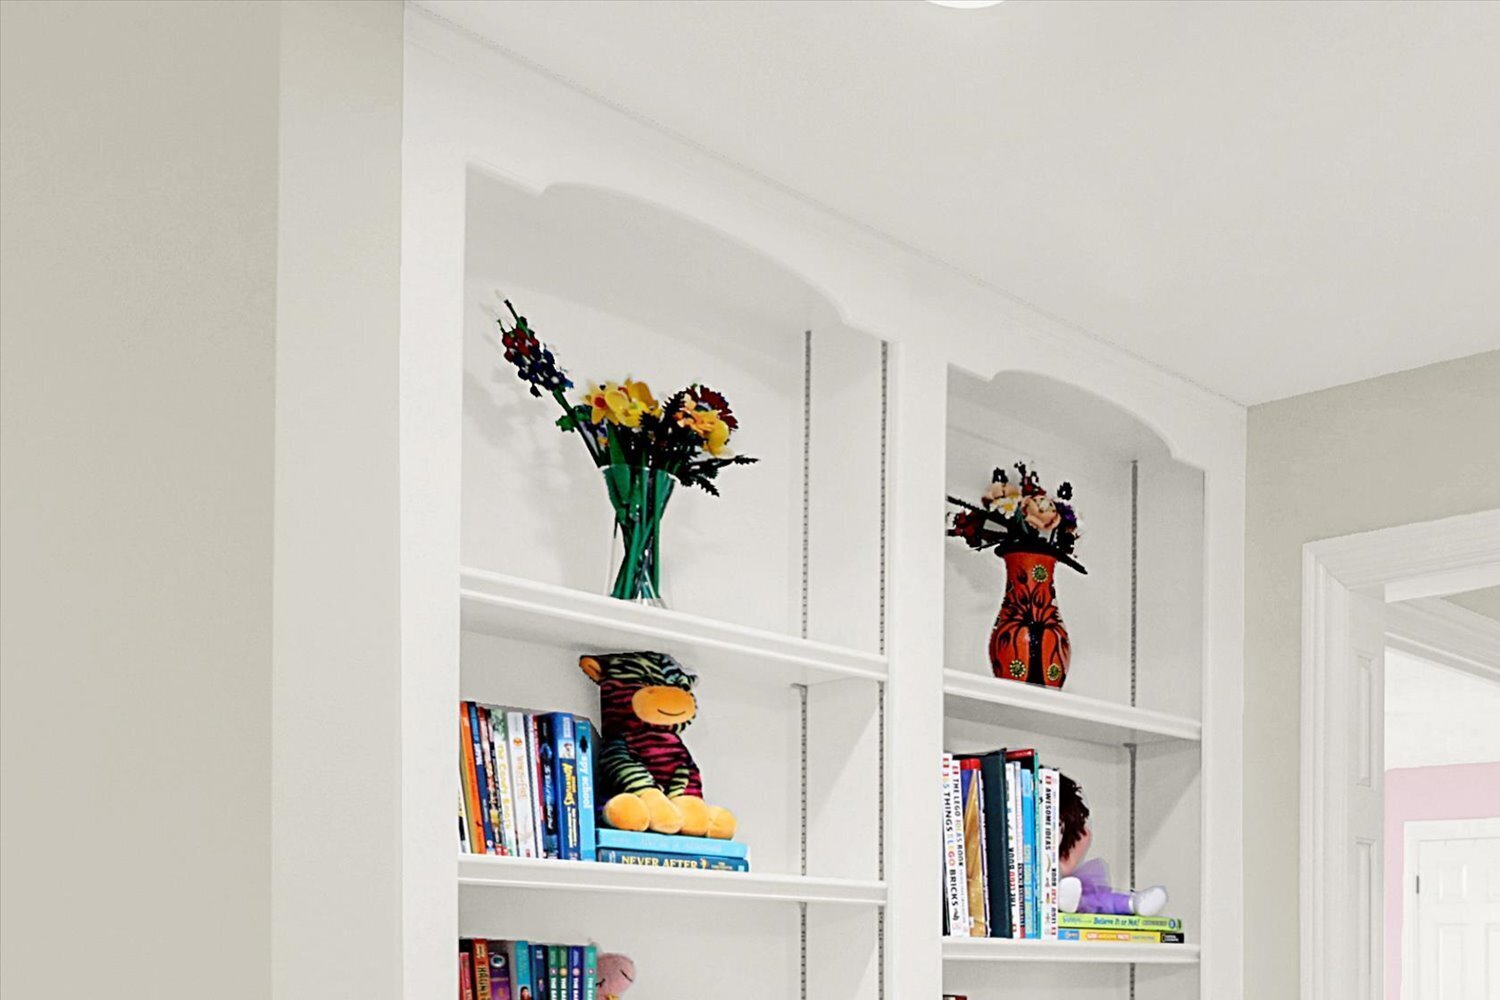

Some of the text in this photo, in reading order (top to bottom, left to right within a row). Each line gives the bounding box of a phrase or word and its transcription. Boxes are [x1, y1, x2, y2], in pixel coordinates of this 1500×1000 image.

[581, 776, 592, 808] school
[953, 796, 961, 816] LEGO
[622, 855, 698, 869] NEVER AFTER
[944, 792, 953, 832] THINGS
[949, 869, 958, 906] BRICKS
